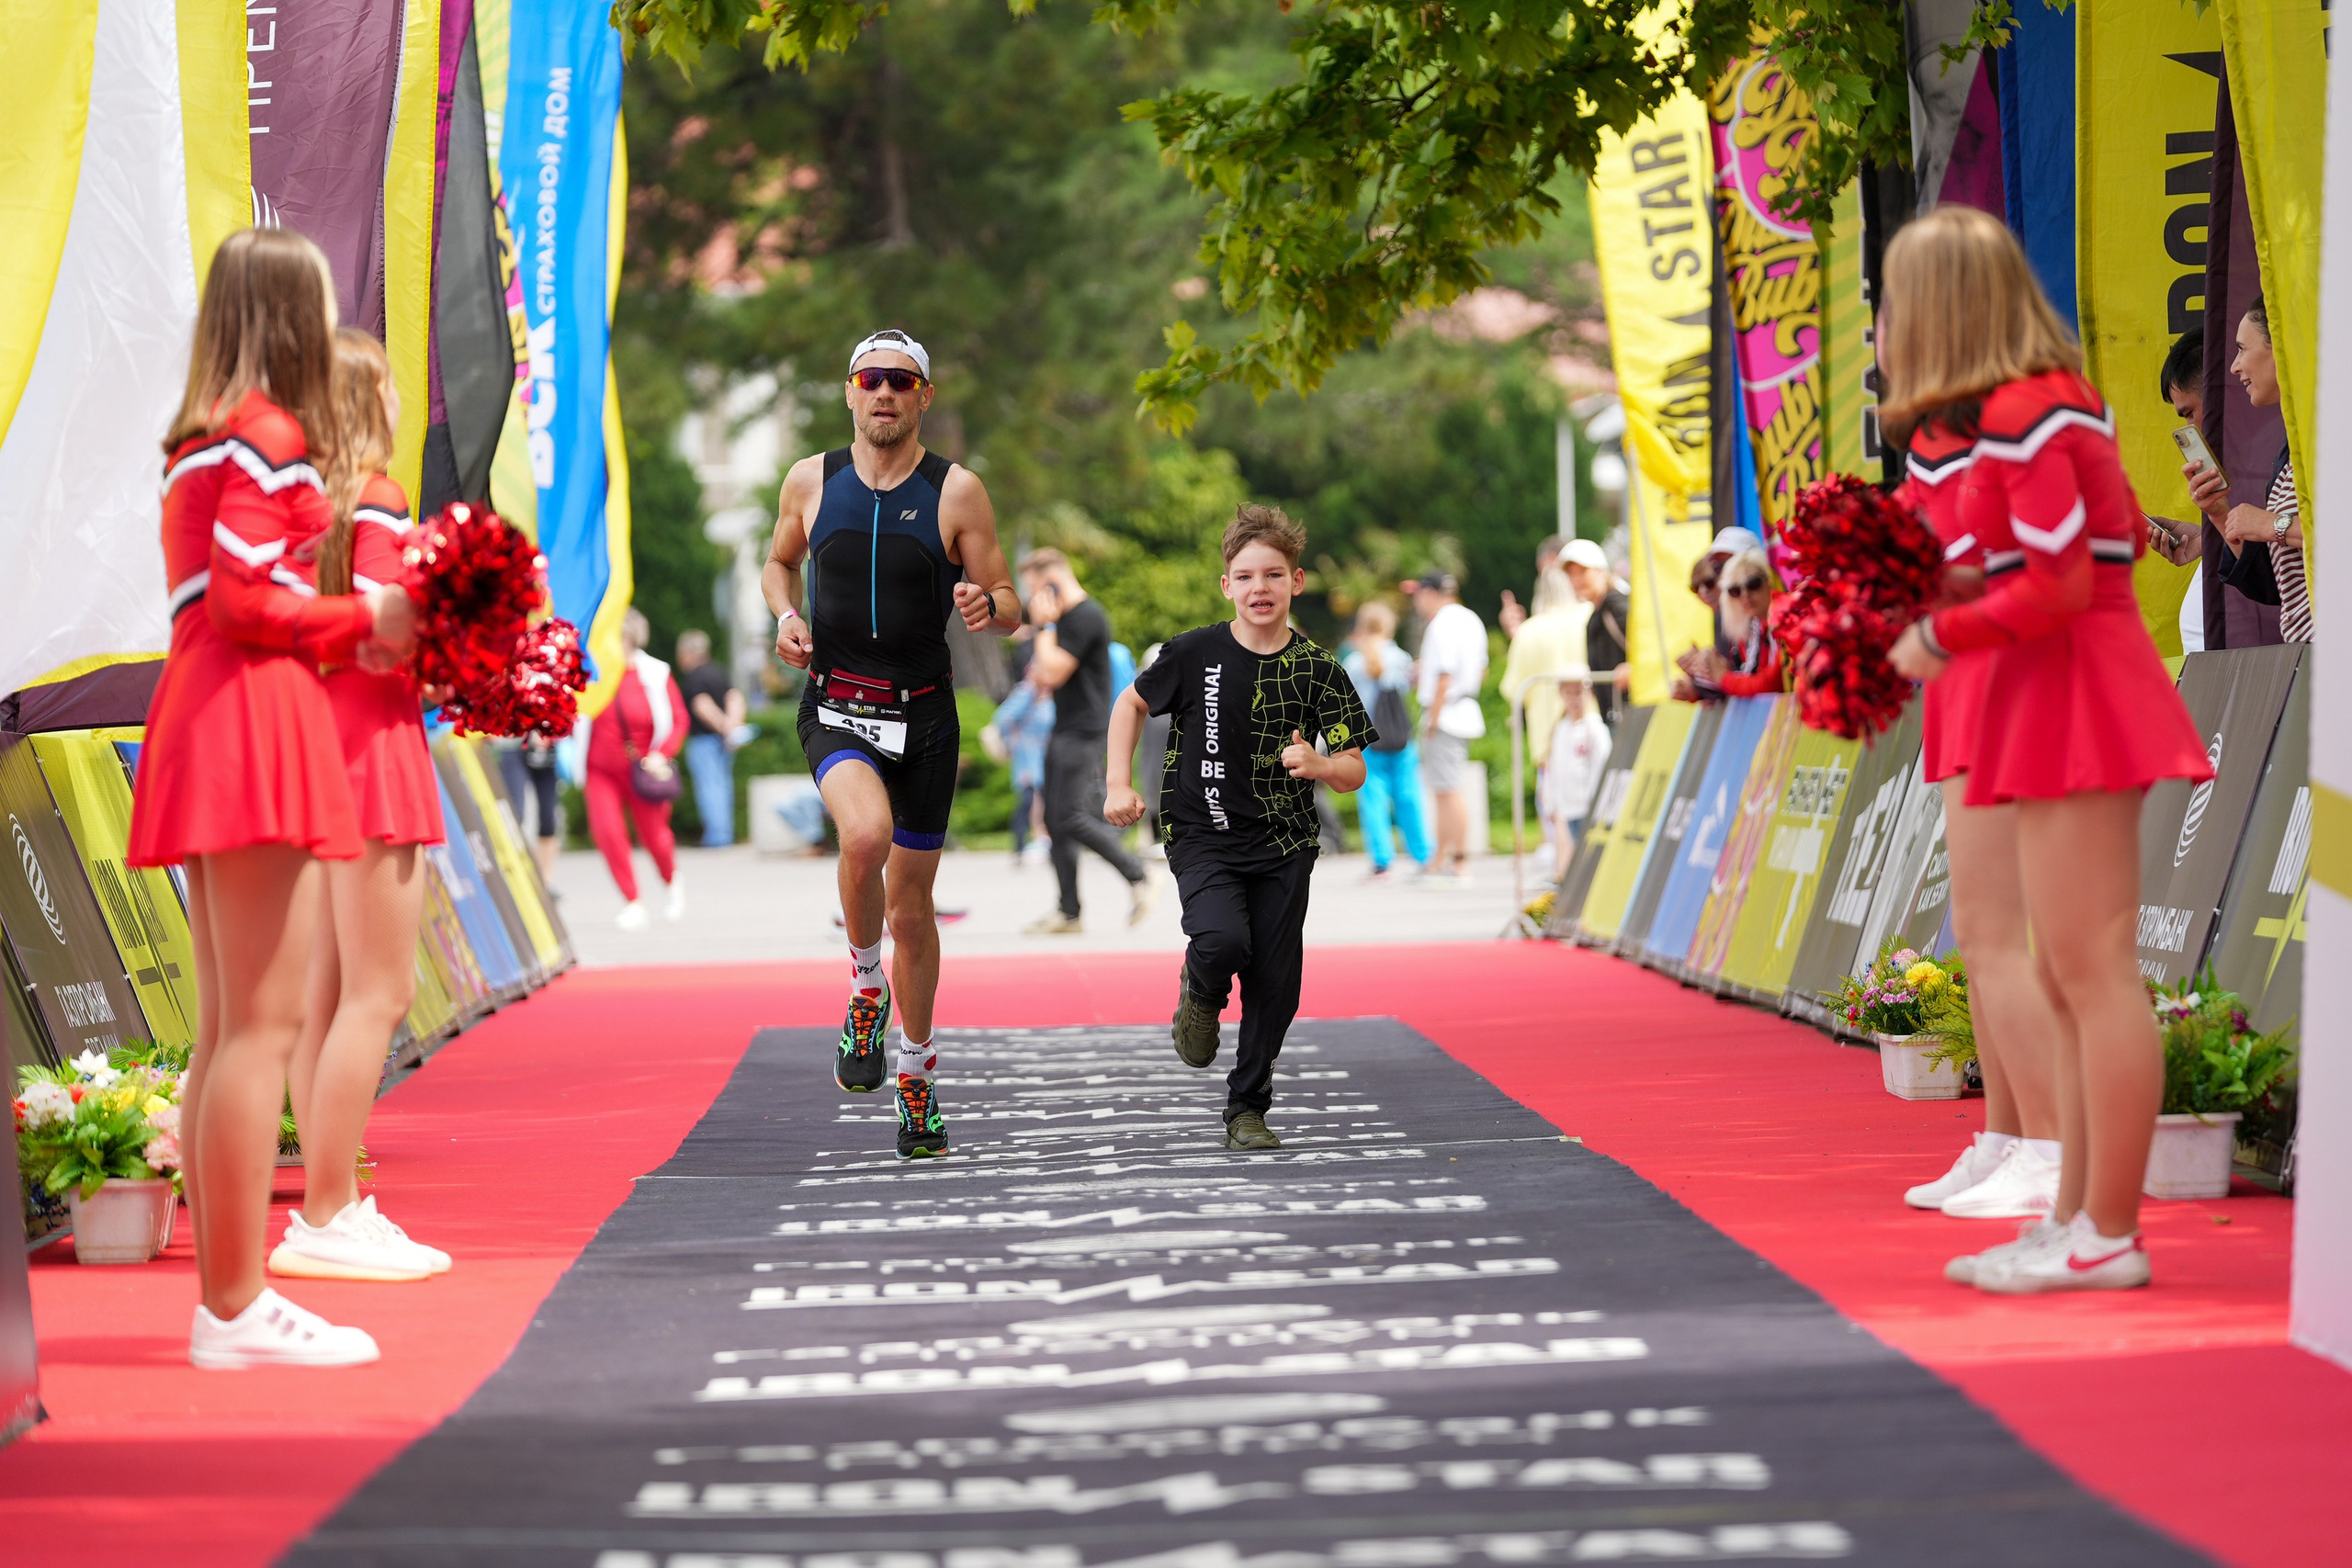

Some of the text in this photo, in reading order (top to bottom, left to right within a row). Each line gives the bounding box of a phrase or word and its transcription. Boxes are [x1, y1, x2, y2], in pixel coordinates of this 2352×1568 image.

[536, 67, 571, 316] СТРАХОВОЙ ДОМ
[1630, 130, 1702, 282] STAR
[1204, 663, 1222, 754] ORIGINAL
[1201, 760, 1226, 779] BE
[1198, 1195, 1488, 1214] STAR
